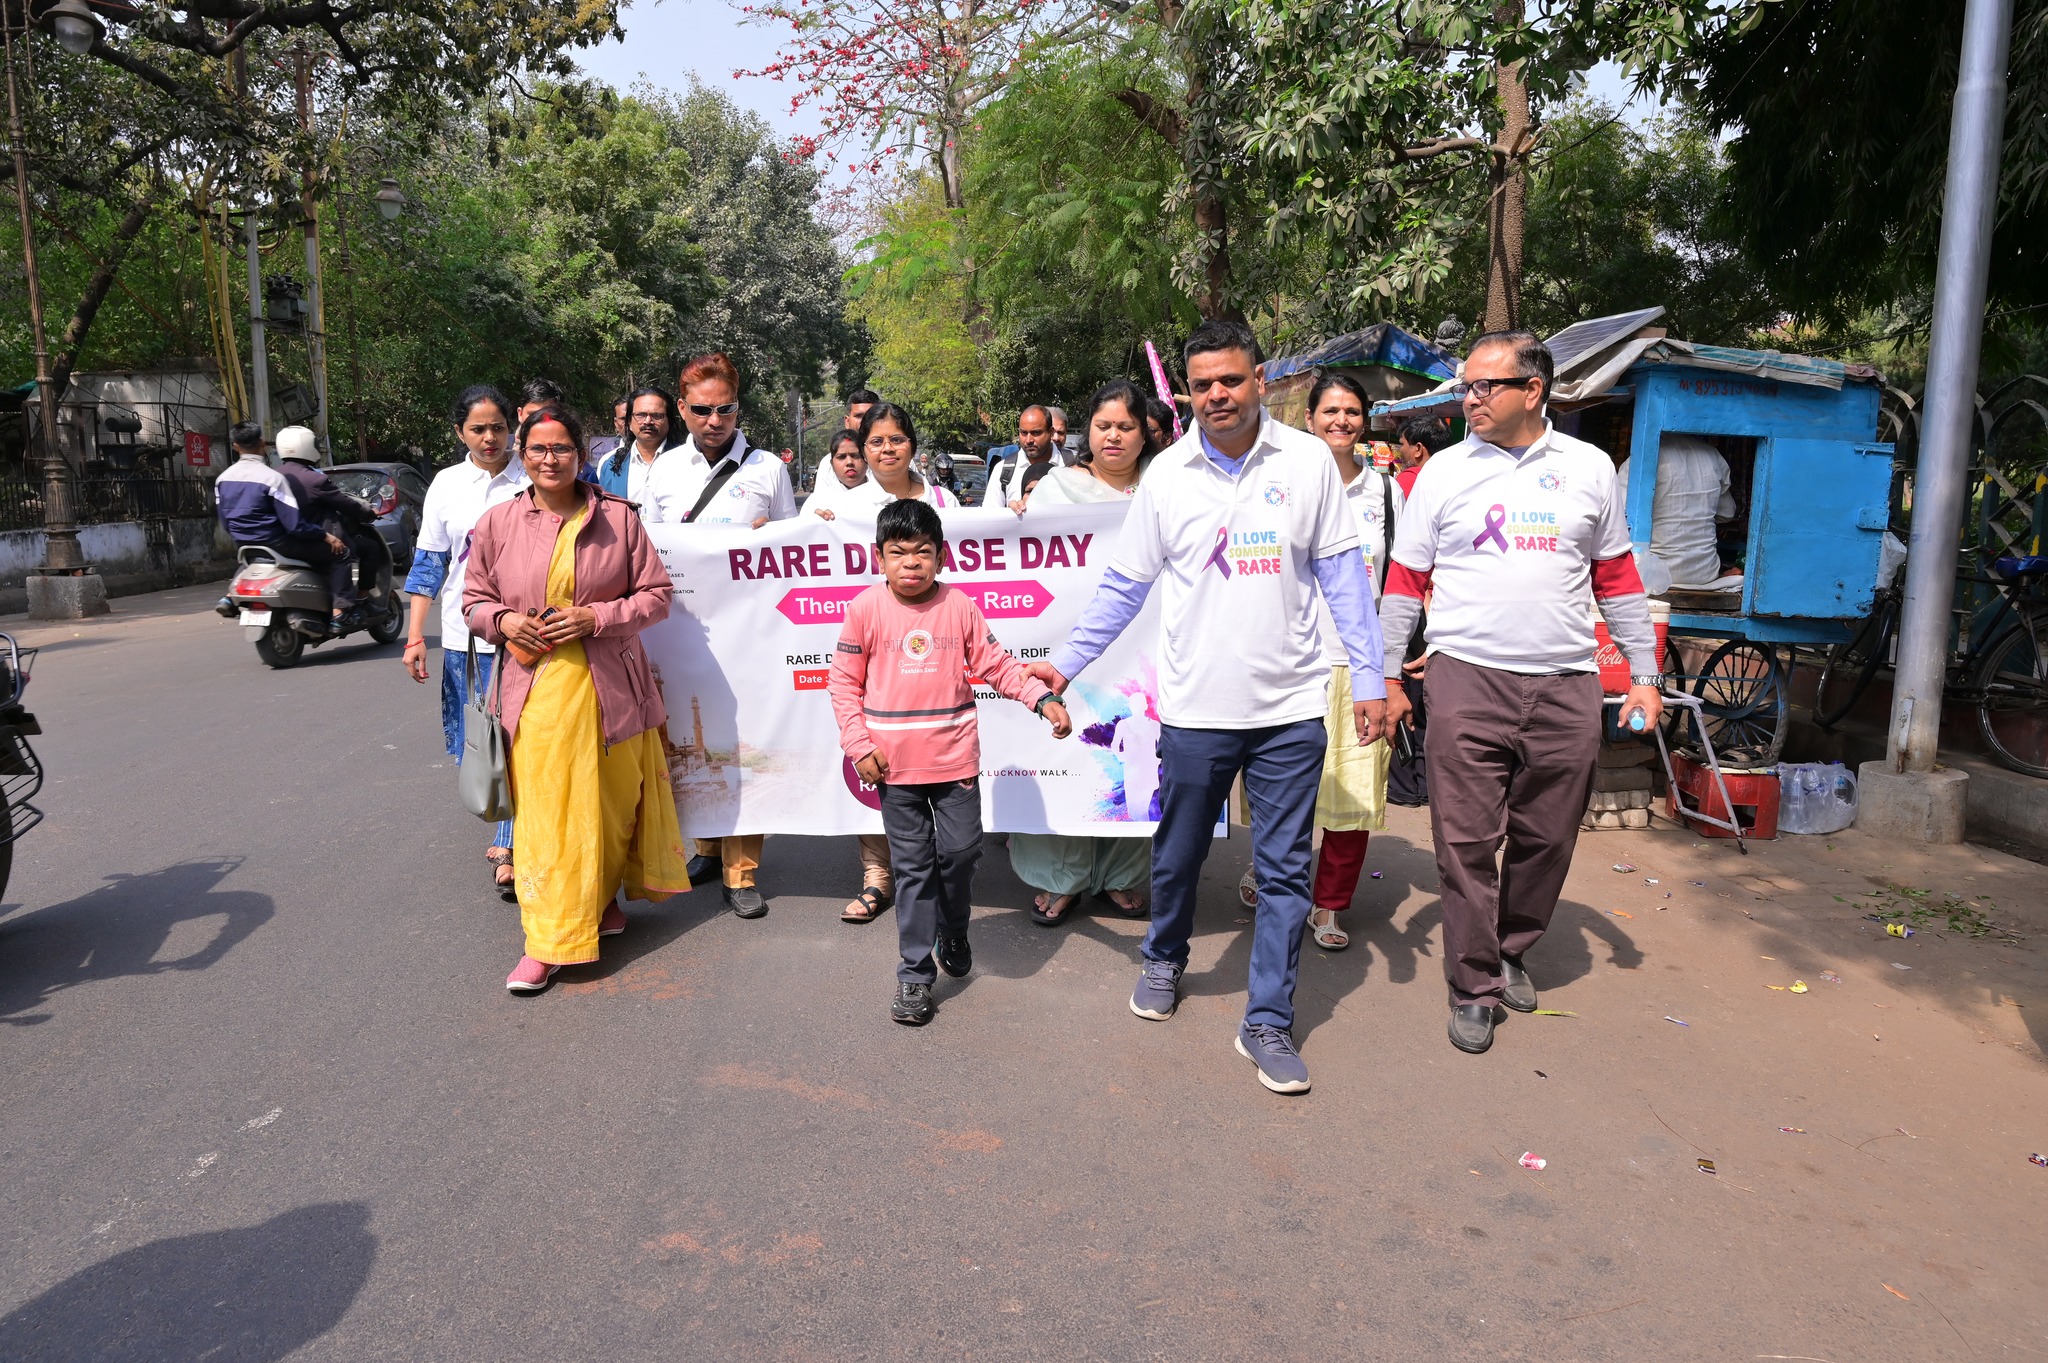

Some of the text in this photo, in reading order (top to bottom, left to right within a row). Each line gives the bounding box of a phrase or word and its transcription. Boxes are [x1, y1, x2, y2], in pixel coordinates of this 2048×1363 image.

[1512, 511, 1556, 524] I LOVE
[1506, 524, 1560, 536] SOMEONE
[1234, 531, 1277, 545] I LOVE
[1514, 535, 1557, 552] RARE
[728, 543, 831, 581] RARE
[1019, 533, 1094, 570] DAY
[1229, 545, 1282, 558] SOMEONE
[1237, 558, 1281, 576] RARE
[795, 591, 1035, 615] Them Rare
[786, 654, 821, 665] RARE
[1021, 647, 1051, 658] RDIF
[799, 675, 823, 684] Date
[987, 769, 1038, 777] LUCKNOW
